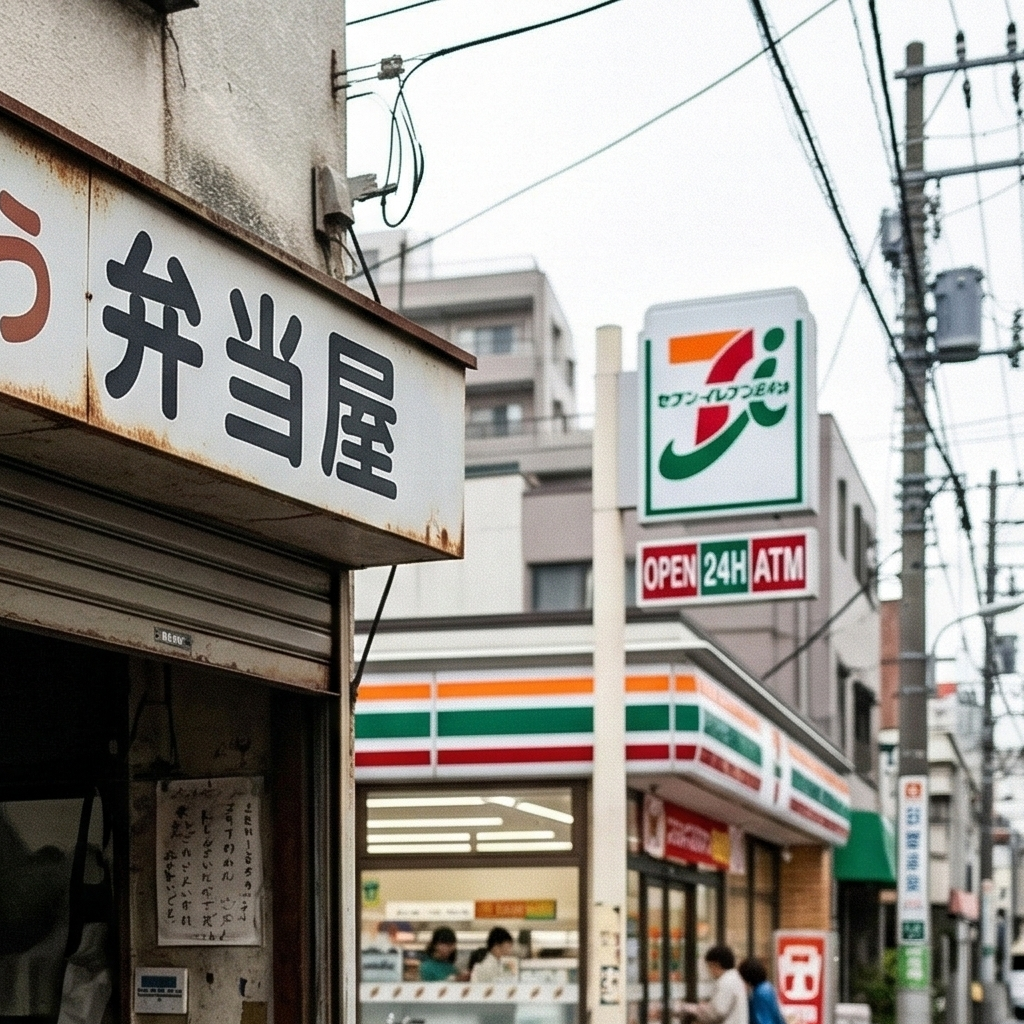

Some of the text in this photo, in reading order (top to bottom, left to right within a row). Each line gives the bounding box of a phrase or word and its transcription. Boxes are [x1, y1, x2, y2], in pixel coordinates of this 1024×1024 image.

[102, 230, 397, 500] 弁当屋
[643, 545, 805, 592] OPEN 24H ATM
